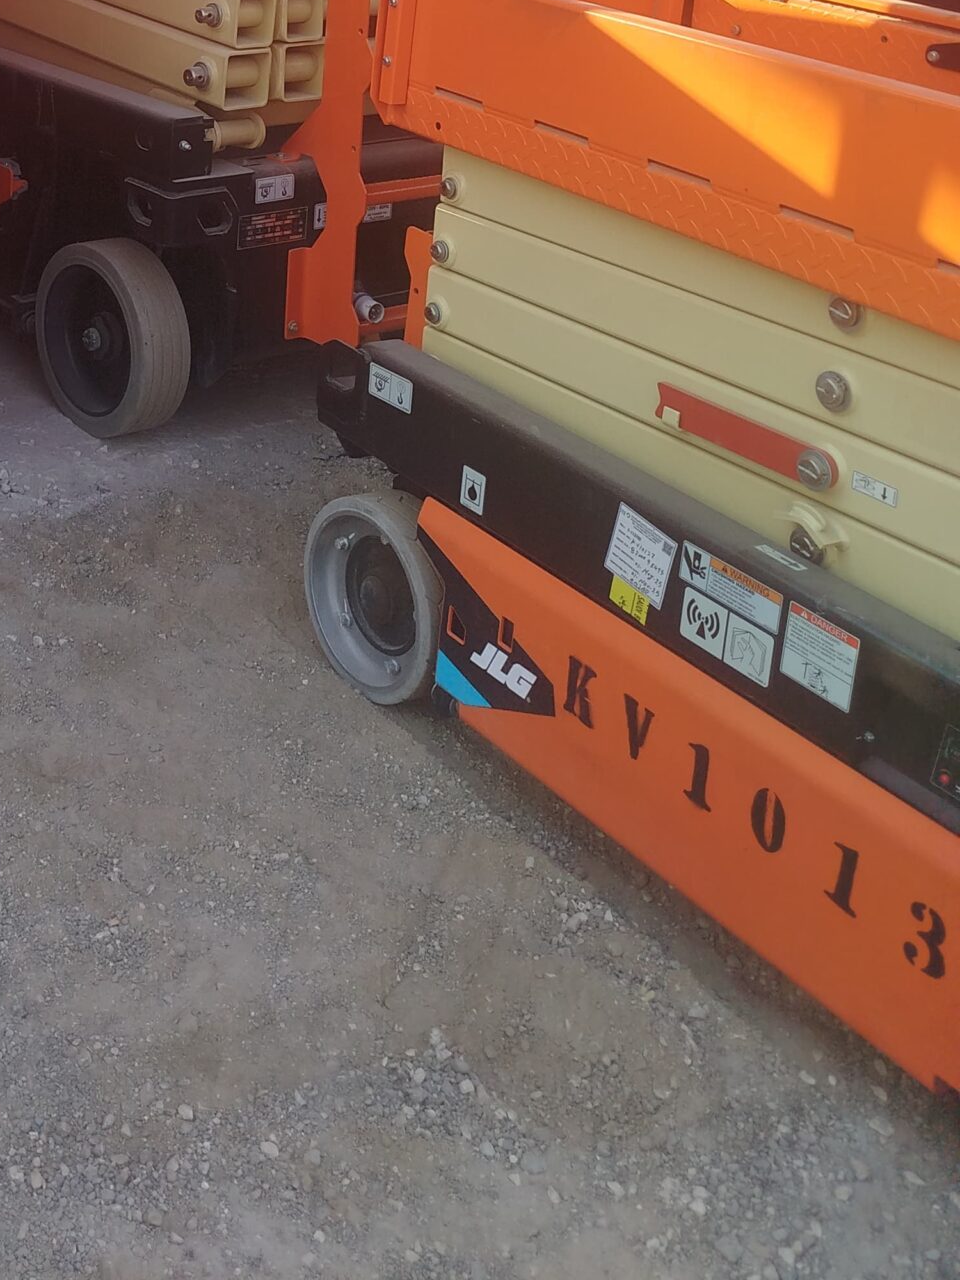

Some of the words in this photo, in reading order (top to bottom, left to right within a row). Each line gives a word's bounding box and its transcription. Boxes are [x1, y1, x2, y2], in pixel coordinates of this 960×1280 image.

[729, 568, 770, 597] WARNING
[811, 614, 848, 642] DANGER
[469, 642, 538, 700] JLG
